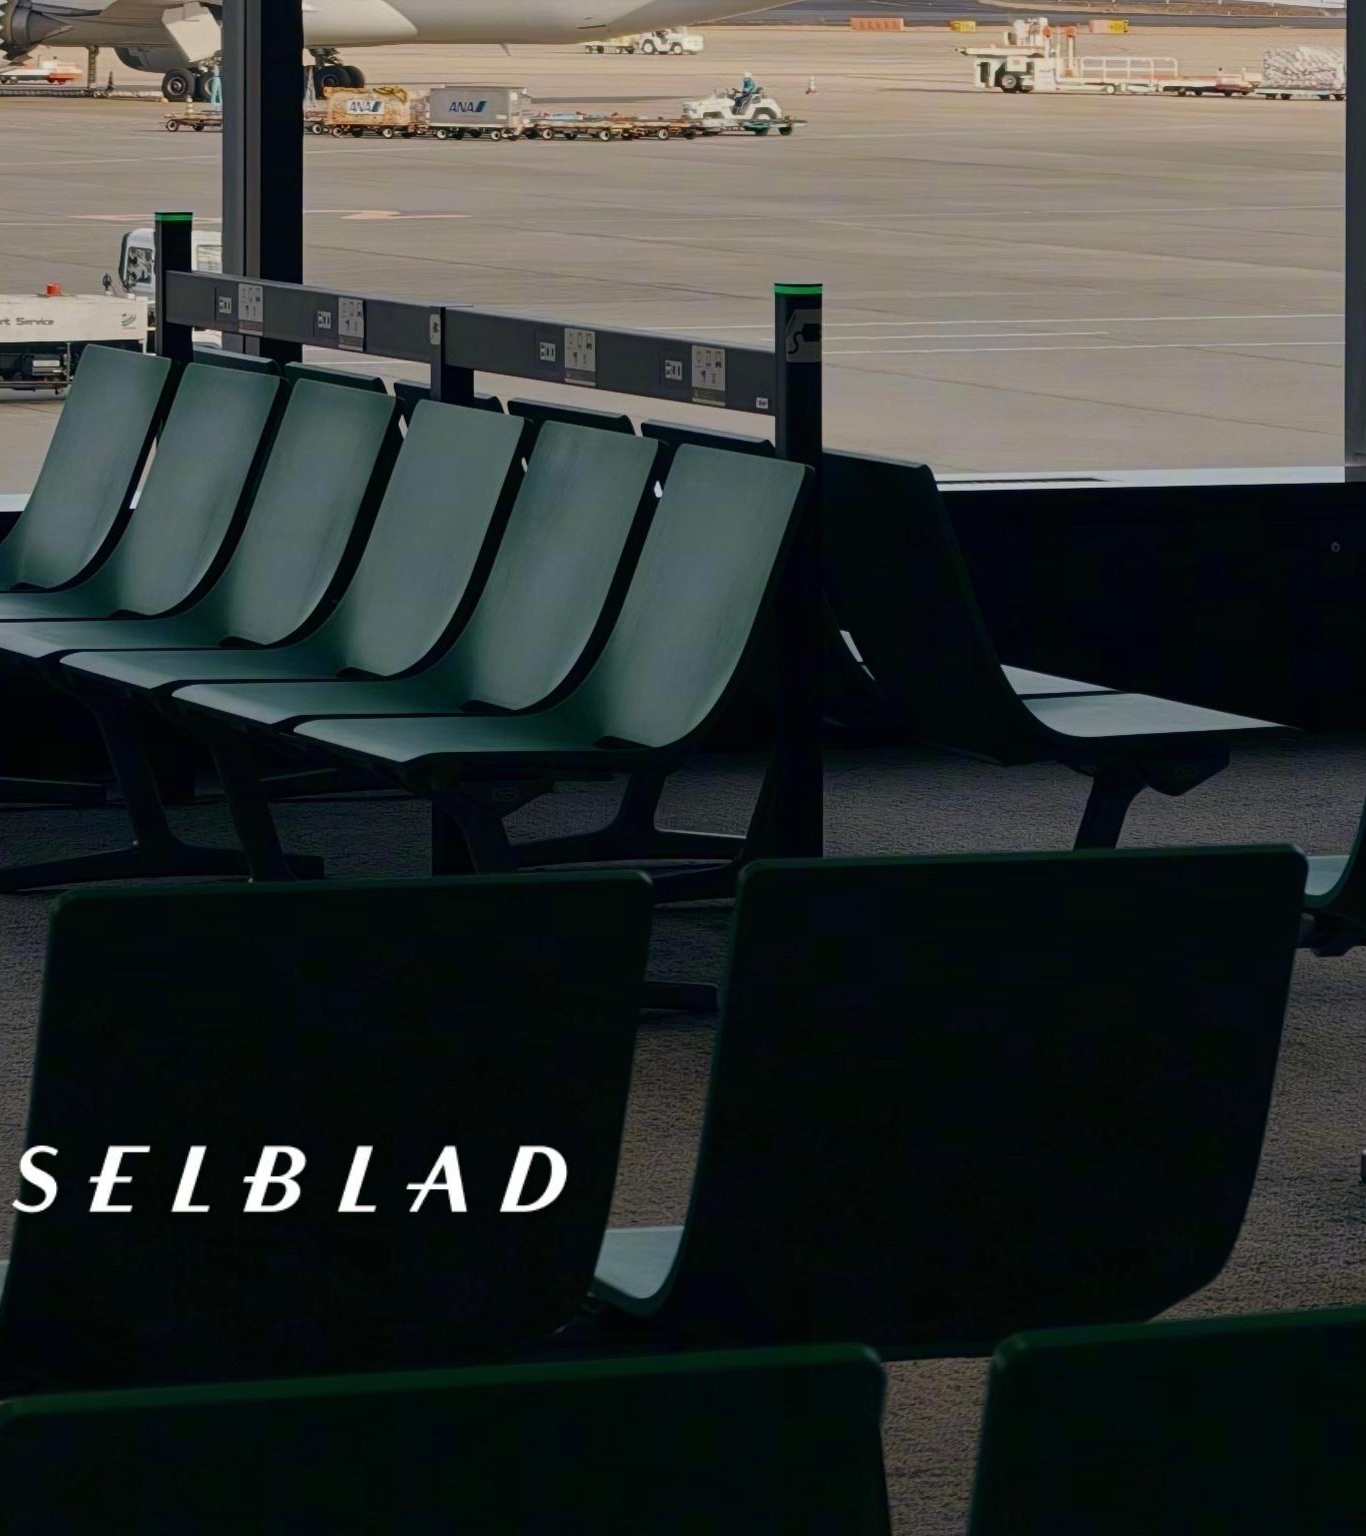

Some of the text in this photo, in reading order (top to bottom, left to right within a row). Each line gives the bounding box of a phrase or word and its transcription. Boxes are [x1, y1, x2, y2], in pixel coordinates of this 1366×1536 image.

[349, 101, 373, 113] ANA
[448, 101, 475, 113] ANA
[15, 317, 55, 326] Service
